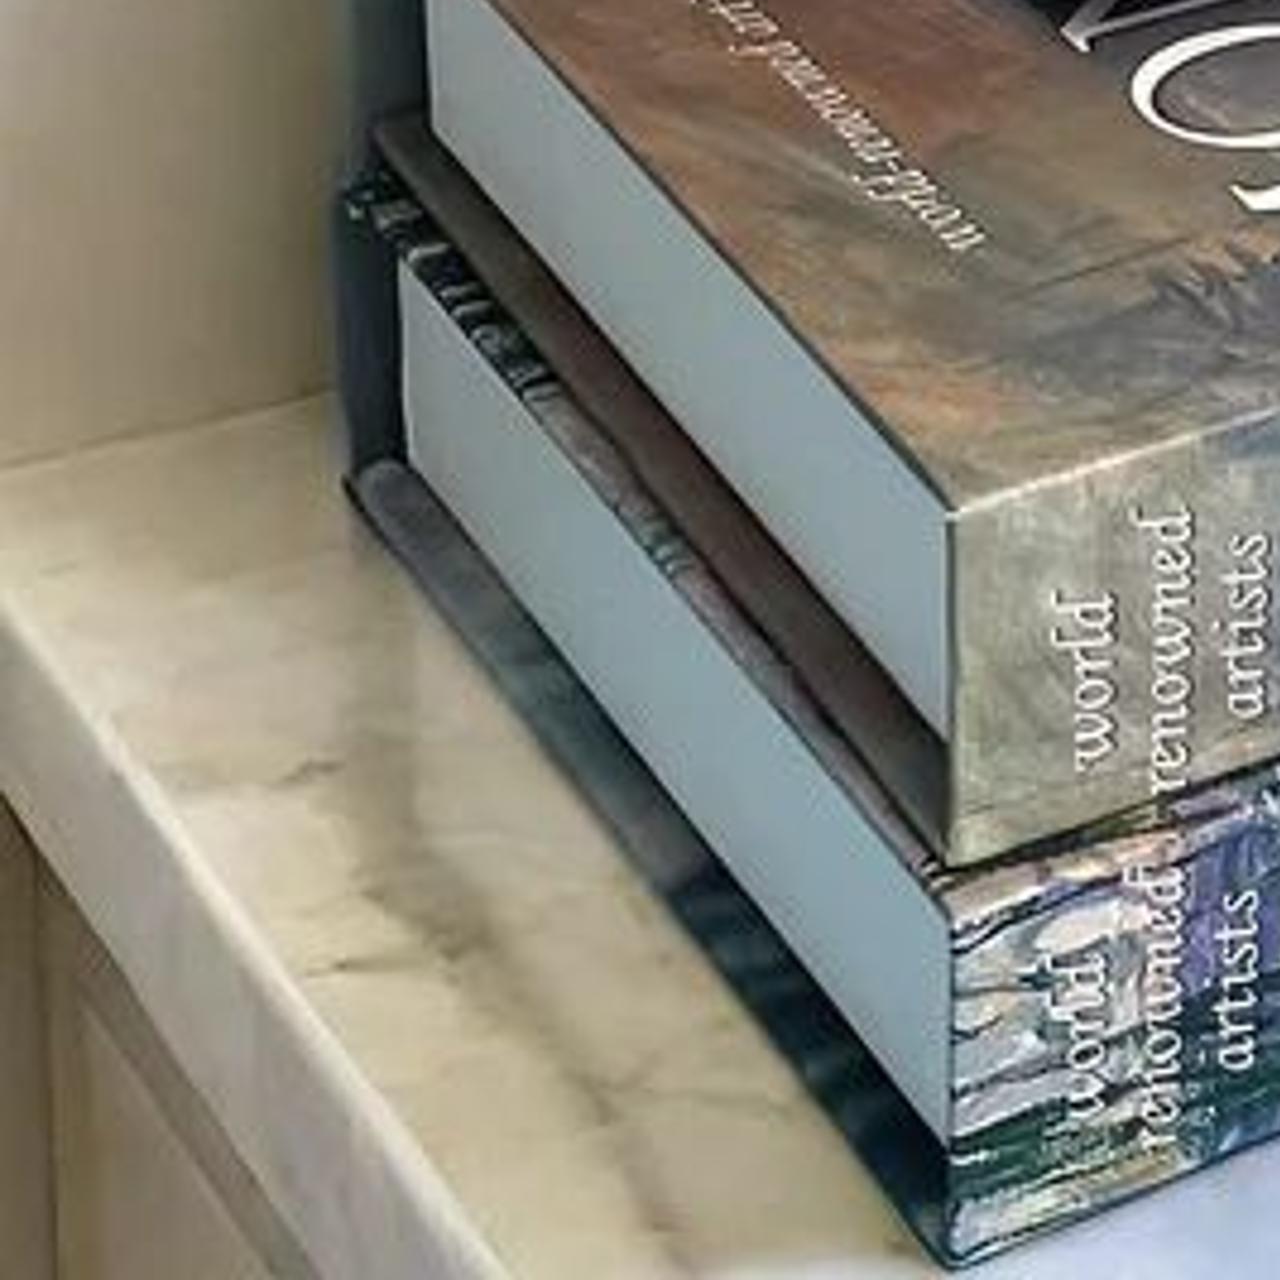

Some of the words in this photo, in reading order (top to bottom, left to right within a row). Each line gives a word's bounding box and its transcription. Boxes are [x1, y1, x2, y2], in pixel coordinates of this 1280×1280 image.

[1050, 588, 1115, 773] world
[1129, 504, 1192, 797] renowned
[1214, 530, 1270, 719] artists
[1204, 888, 1259, 1073] artists
